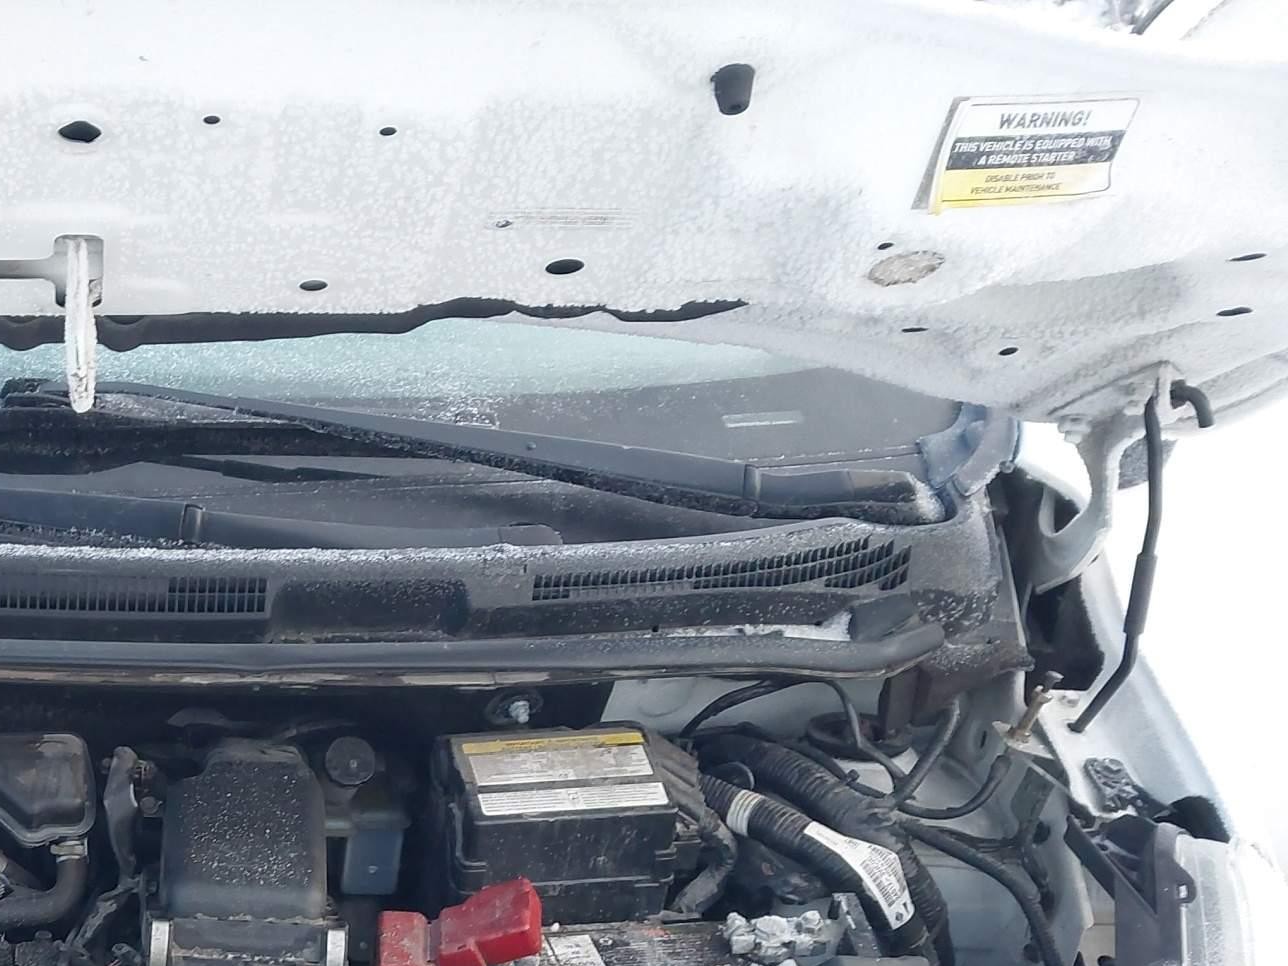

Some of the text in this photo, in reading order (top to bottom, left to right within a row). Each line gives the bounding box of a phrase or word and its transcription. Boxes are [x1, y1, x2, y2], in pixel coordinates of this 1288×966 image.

[999, 110, 1092, 129] WARNING!
[953, 135, 1113, 153] THIS VEHICLE IS EQUIPPED WITH
[977, 151, 1076, 165] A REMOTE STARTER
[984, 172, 1056, 183] DISABLE PRIOR TO
[970, 182, 1062, 195] VEHICLE MAINTENANCE
